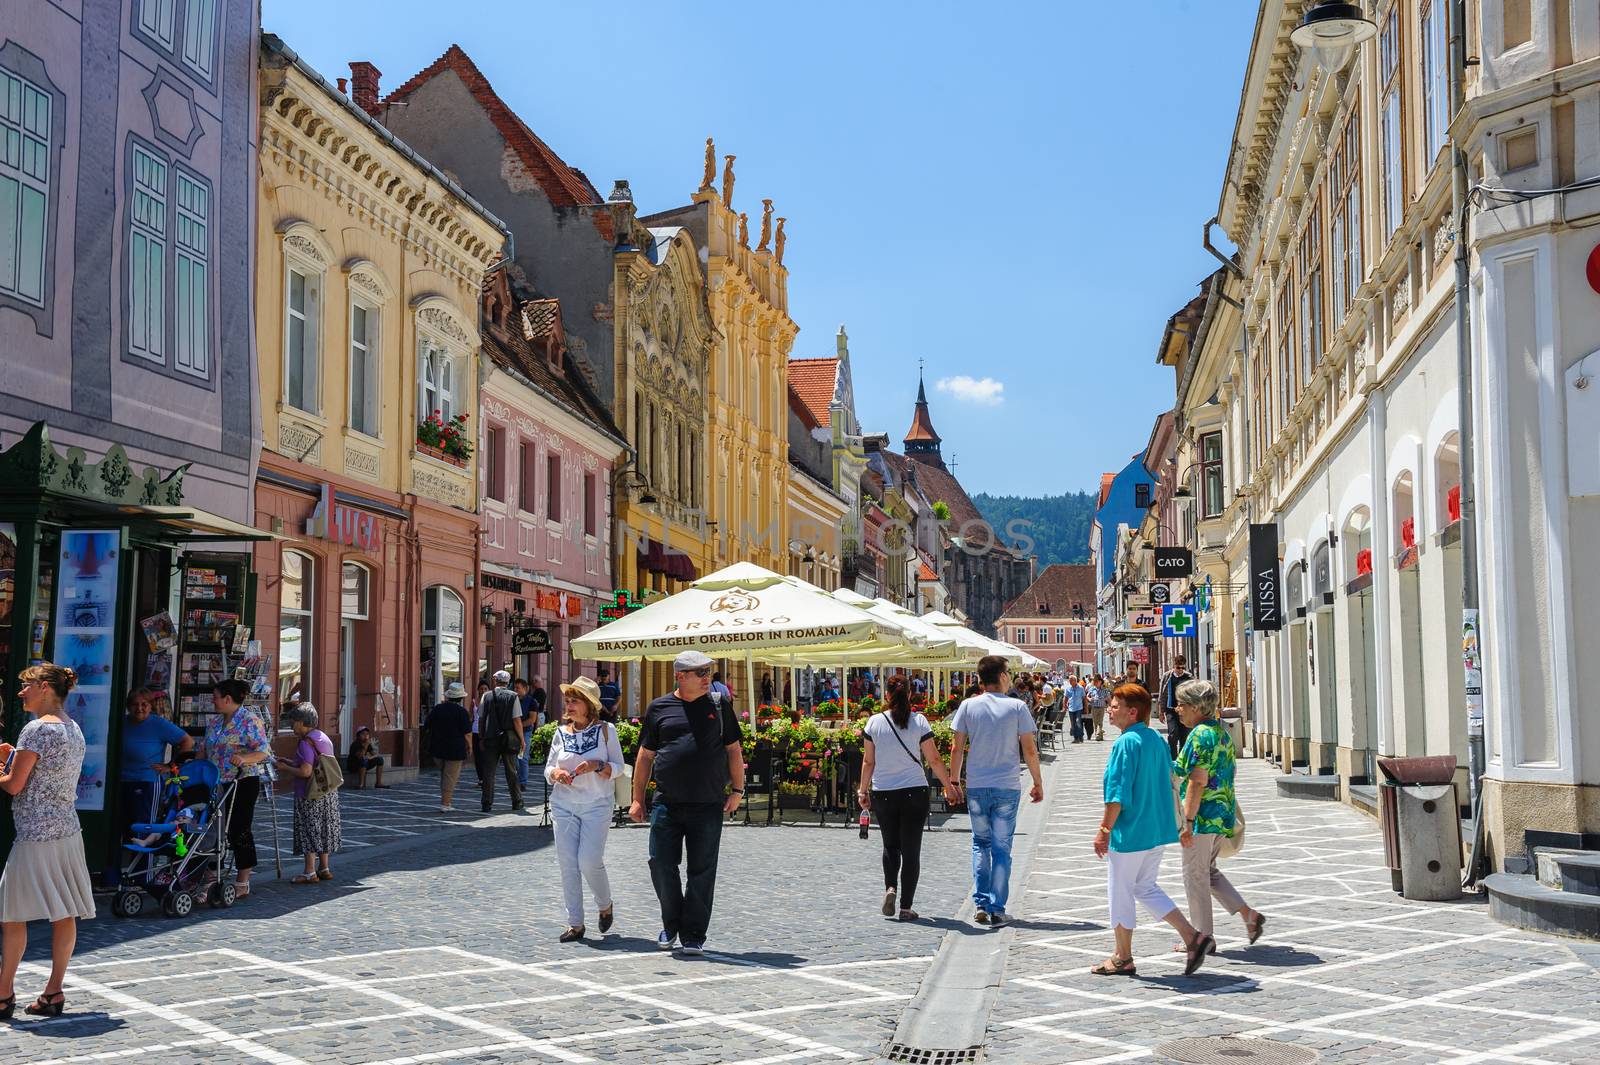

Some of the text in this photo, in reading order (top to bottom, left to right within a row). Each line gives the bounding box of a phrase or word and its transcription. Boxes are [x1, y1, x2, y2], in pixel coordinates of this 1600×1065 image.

[328, 484, 381, 552] LUCA
[1157, 558, 1185, 567] CATO
[1258, 567, 1275, 623] NISSA
[1136, 613, 1155, 625] dm
[652, 636, 695, 648] REGELE
